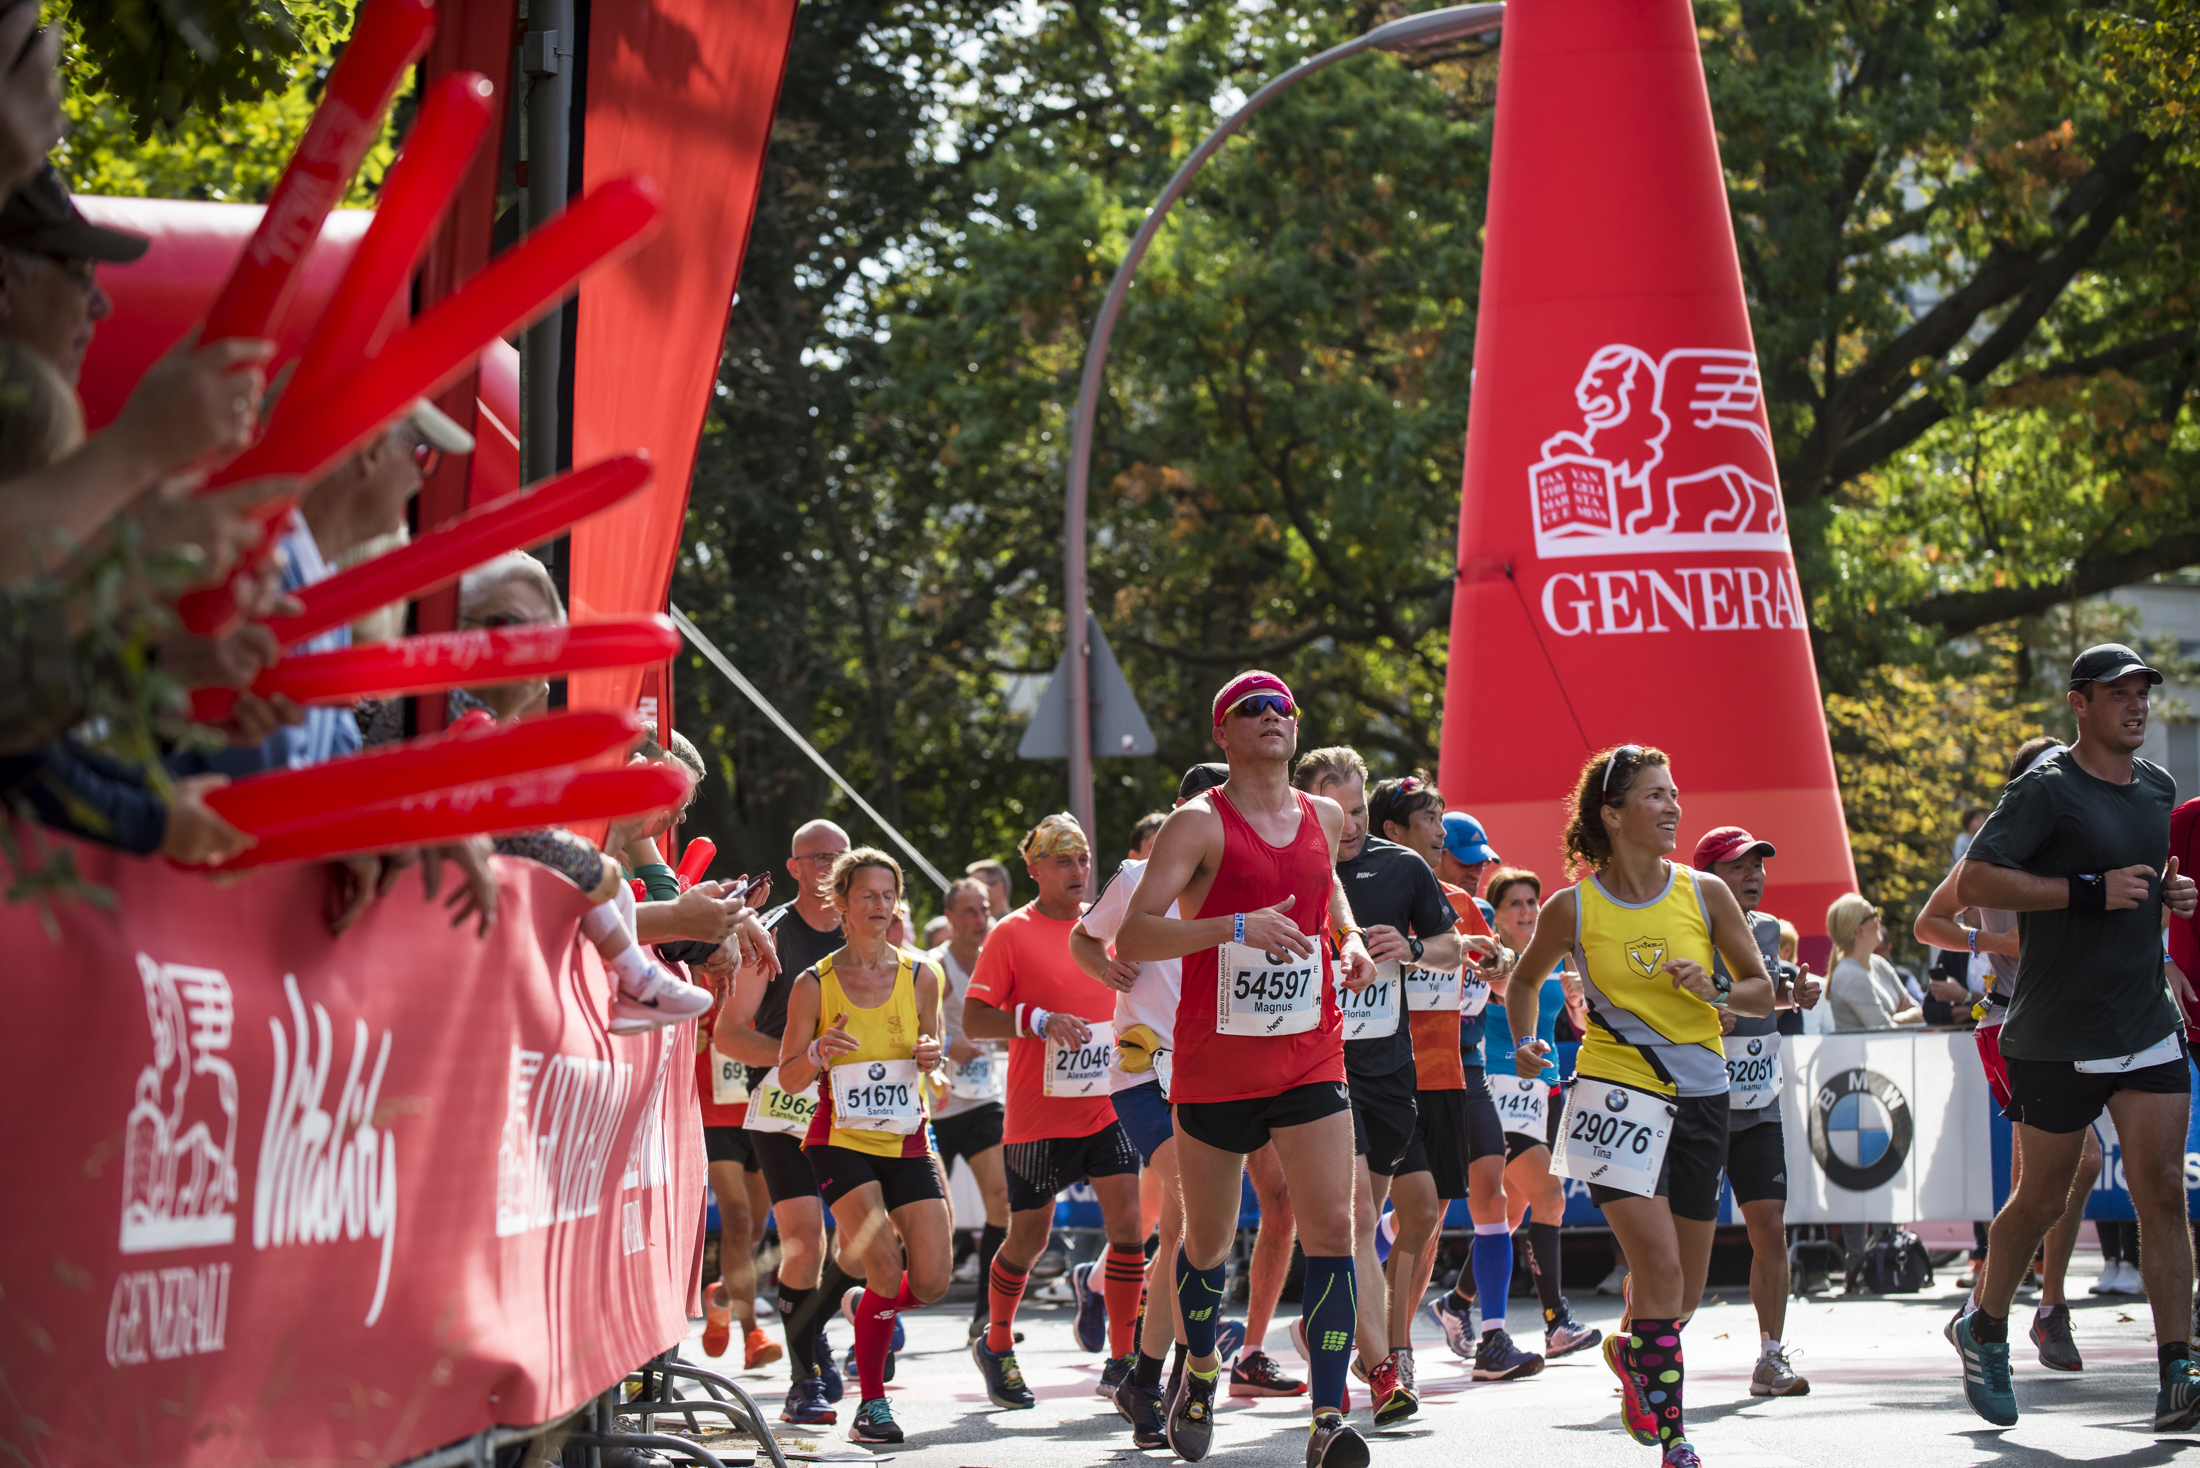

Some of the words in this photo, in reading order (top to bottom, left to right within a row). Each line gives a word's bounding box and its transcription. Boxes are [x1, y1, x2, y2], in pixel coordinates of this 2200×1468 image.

[1313, 965, 1319, 974] E
[1234, 968, 1311, 1000] 54597
[1333, 981, 1388, 1009] 1701
[1254, 1001, 1293, 1015] Magnus
[1343, 1009, 1371, 1018] Florian
[1266, 1015, 1285, 1032] here
[1351, 1022, 1366, 1036] here
[1056, 1045, 1110, 1071] 27046
[2122, 1054, 2135, 1069] here
[1067, 1069, 1104, 1080] Alexander
[848, 1084, 909, 1109] 51670
[1816, 1071, 1905, 1112] BMW
[770, 1109, 800, 1122] Carsten
[867, 1107, 895, 1116] Sandra
[1570, 1110, 1653, 1155] 29076
[1656, 1130, 1665, 1138] C
[252, 971, 399, 1328] Vitality
[1592, 1144, 1613, 1160] Tina
[1590, 1164, 1609, 1179] here
[105, 1261, 232, 1368] GENERALI
[1321, 1343, 1344, 1352] cep
